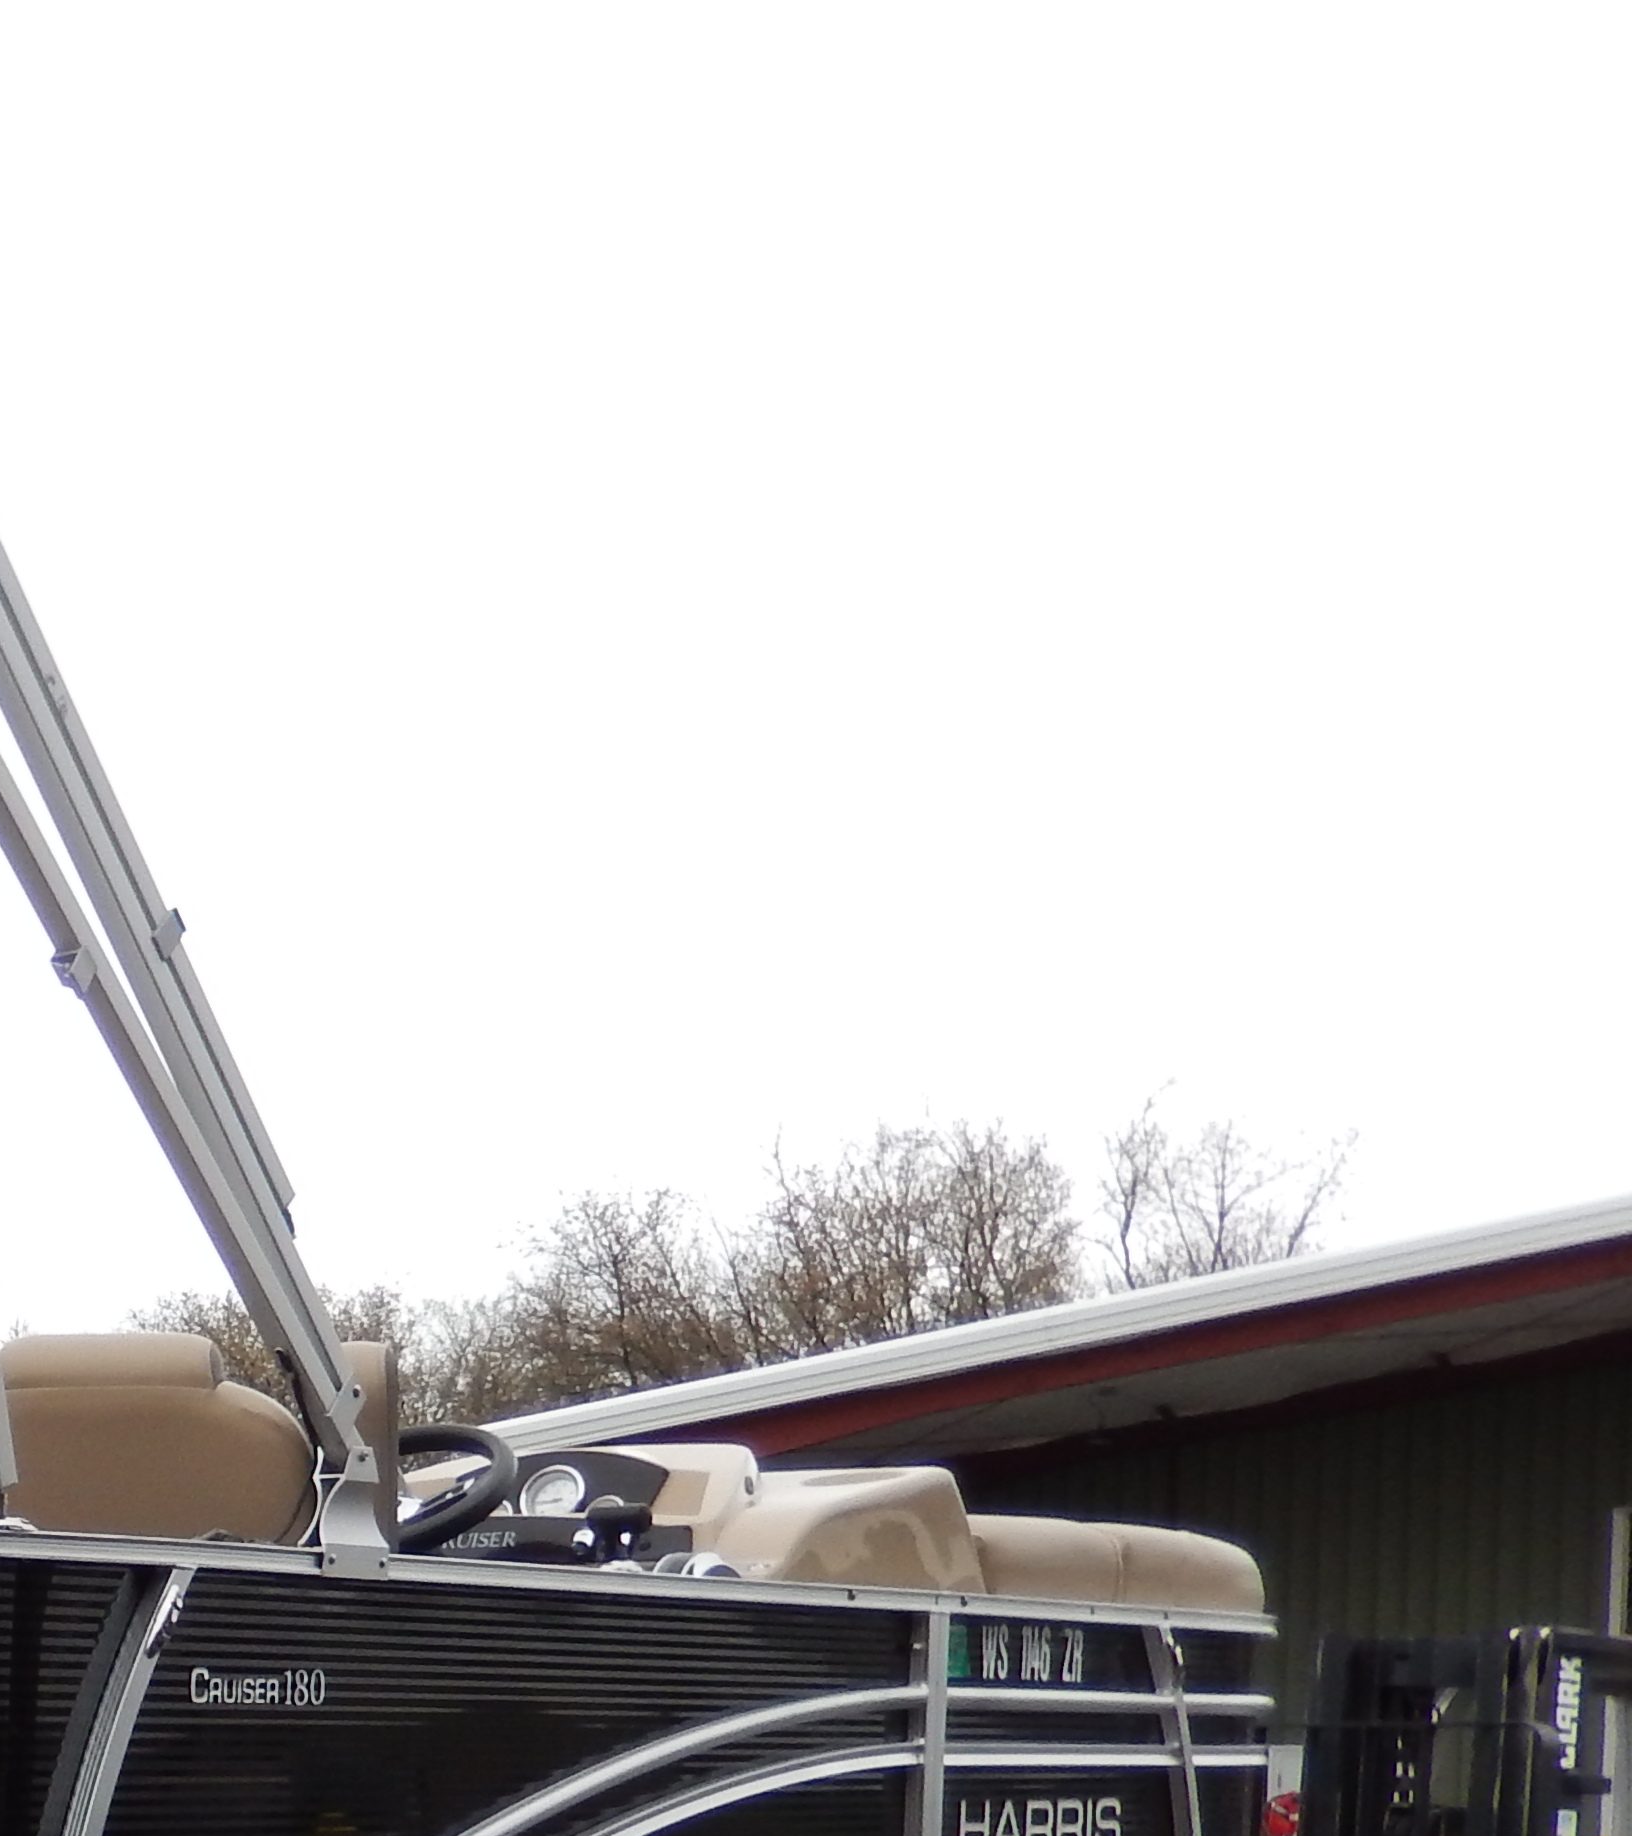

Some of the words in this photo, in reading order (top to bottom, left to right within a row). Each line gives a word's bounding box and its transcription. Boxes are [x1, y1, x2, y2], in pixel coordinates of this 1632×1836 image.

[442, 1531, 517, 1549] UISER
[982, 1625, 1009, 1680] WS
[1060, 1628, 1085, 1683] ZR
[190, 1667, 280, 1704] CRUISER
[284, 1669, 326, 1706] 180
[1556, 1654, 1582, 1770] CLARK
